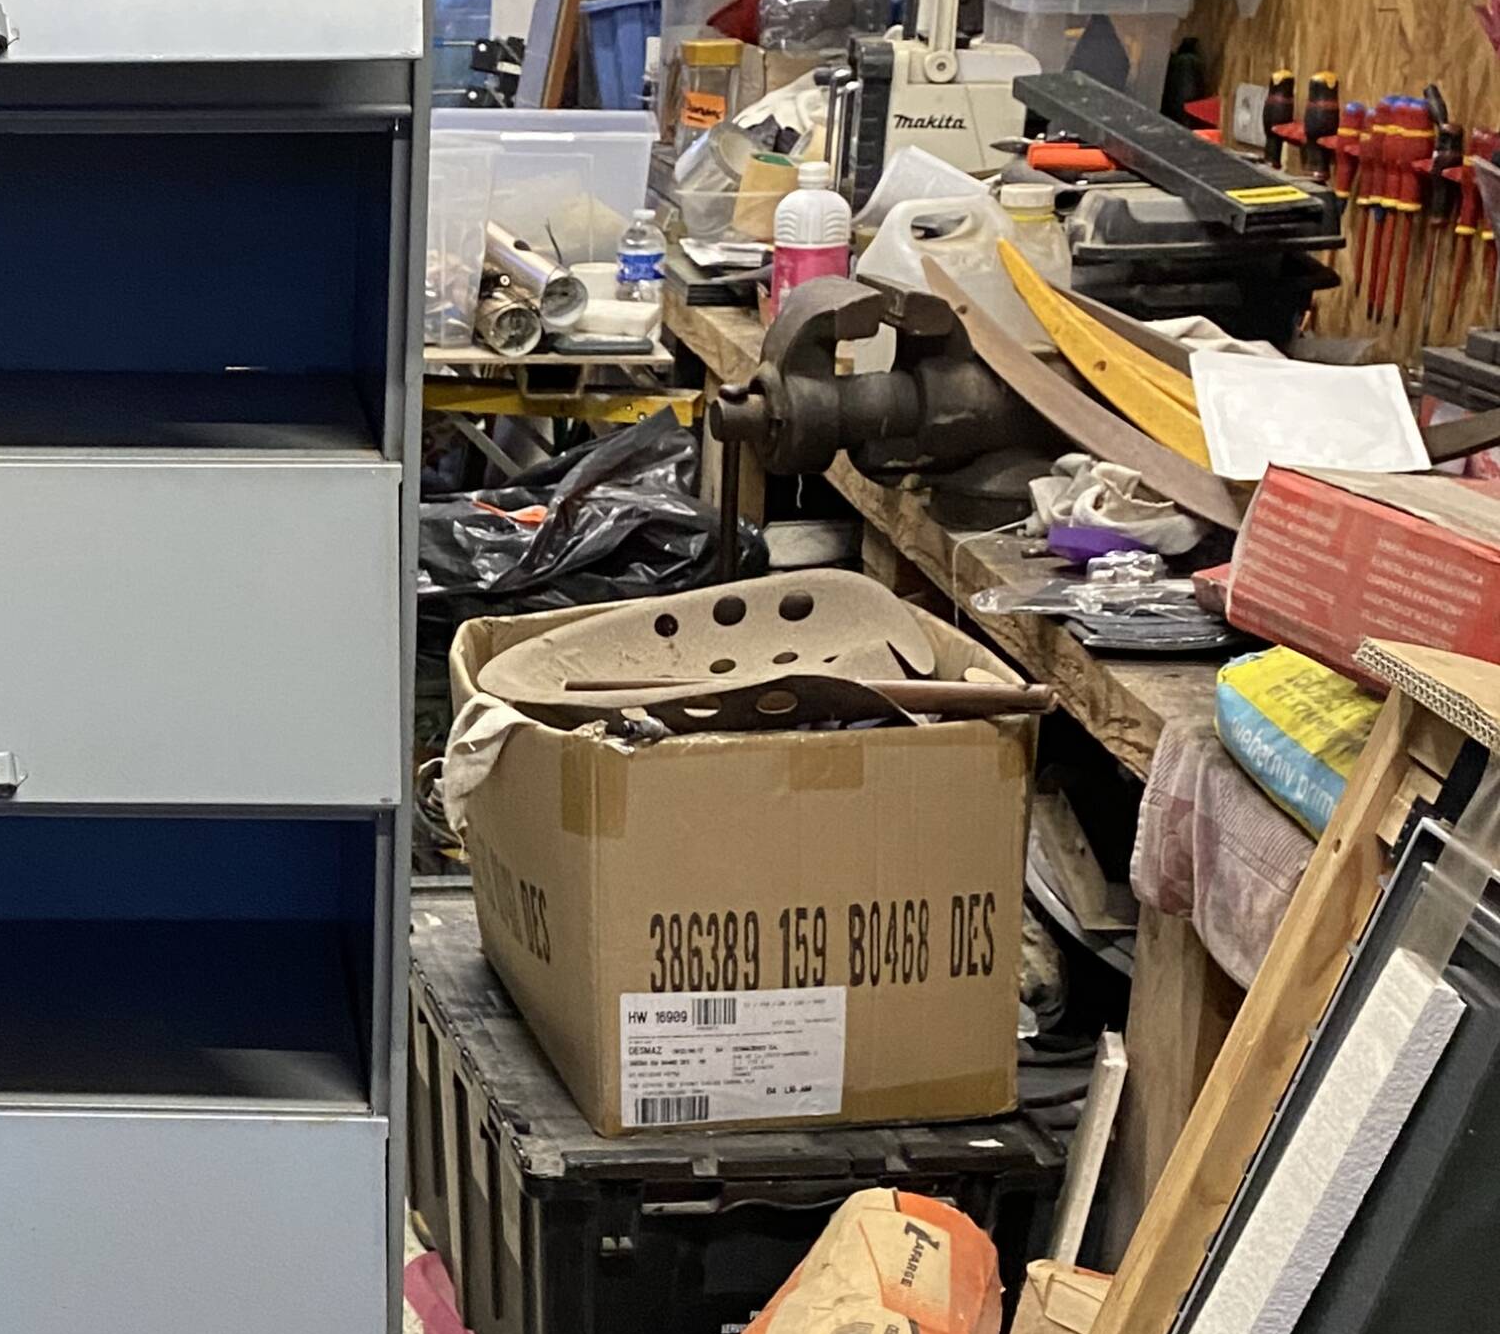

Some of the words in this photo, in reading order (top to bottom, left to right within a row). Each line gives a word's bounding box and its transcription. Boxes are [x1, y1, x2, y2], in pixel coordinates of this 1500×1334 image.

[650, 910, 760, 992] 386389
[779, 906, 827, 989] 159
[850, 898, 929, 987] B0468
[950, 892, 995, 978] DES
[627, 1011, 648, 1024] HW
